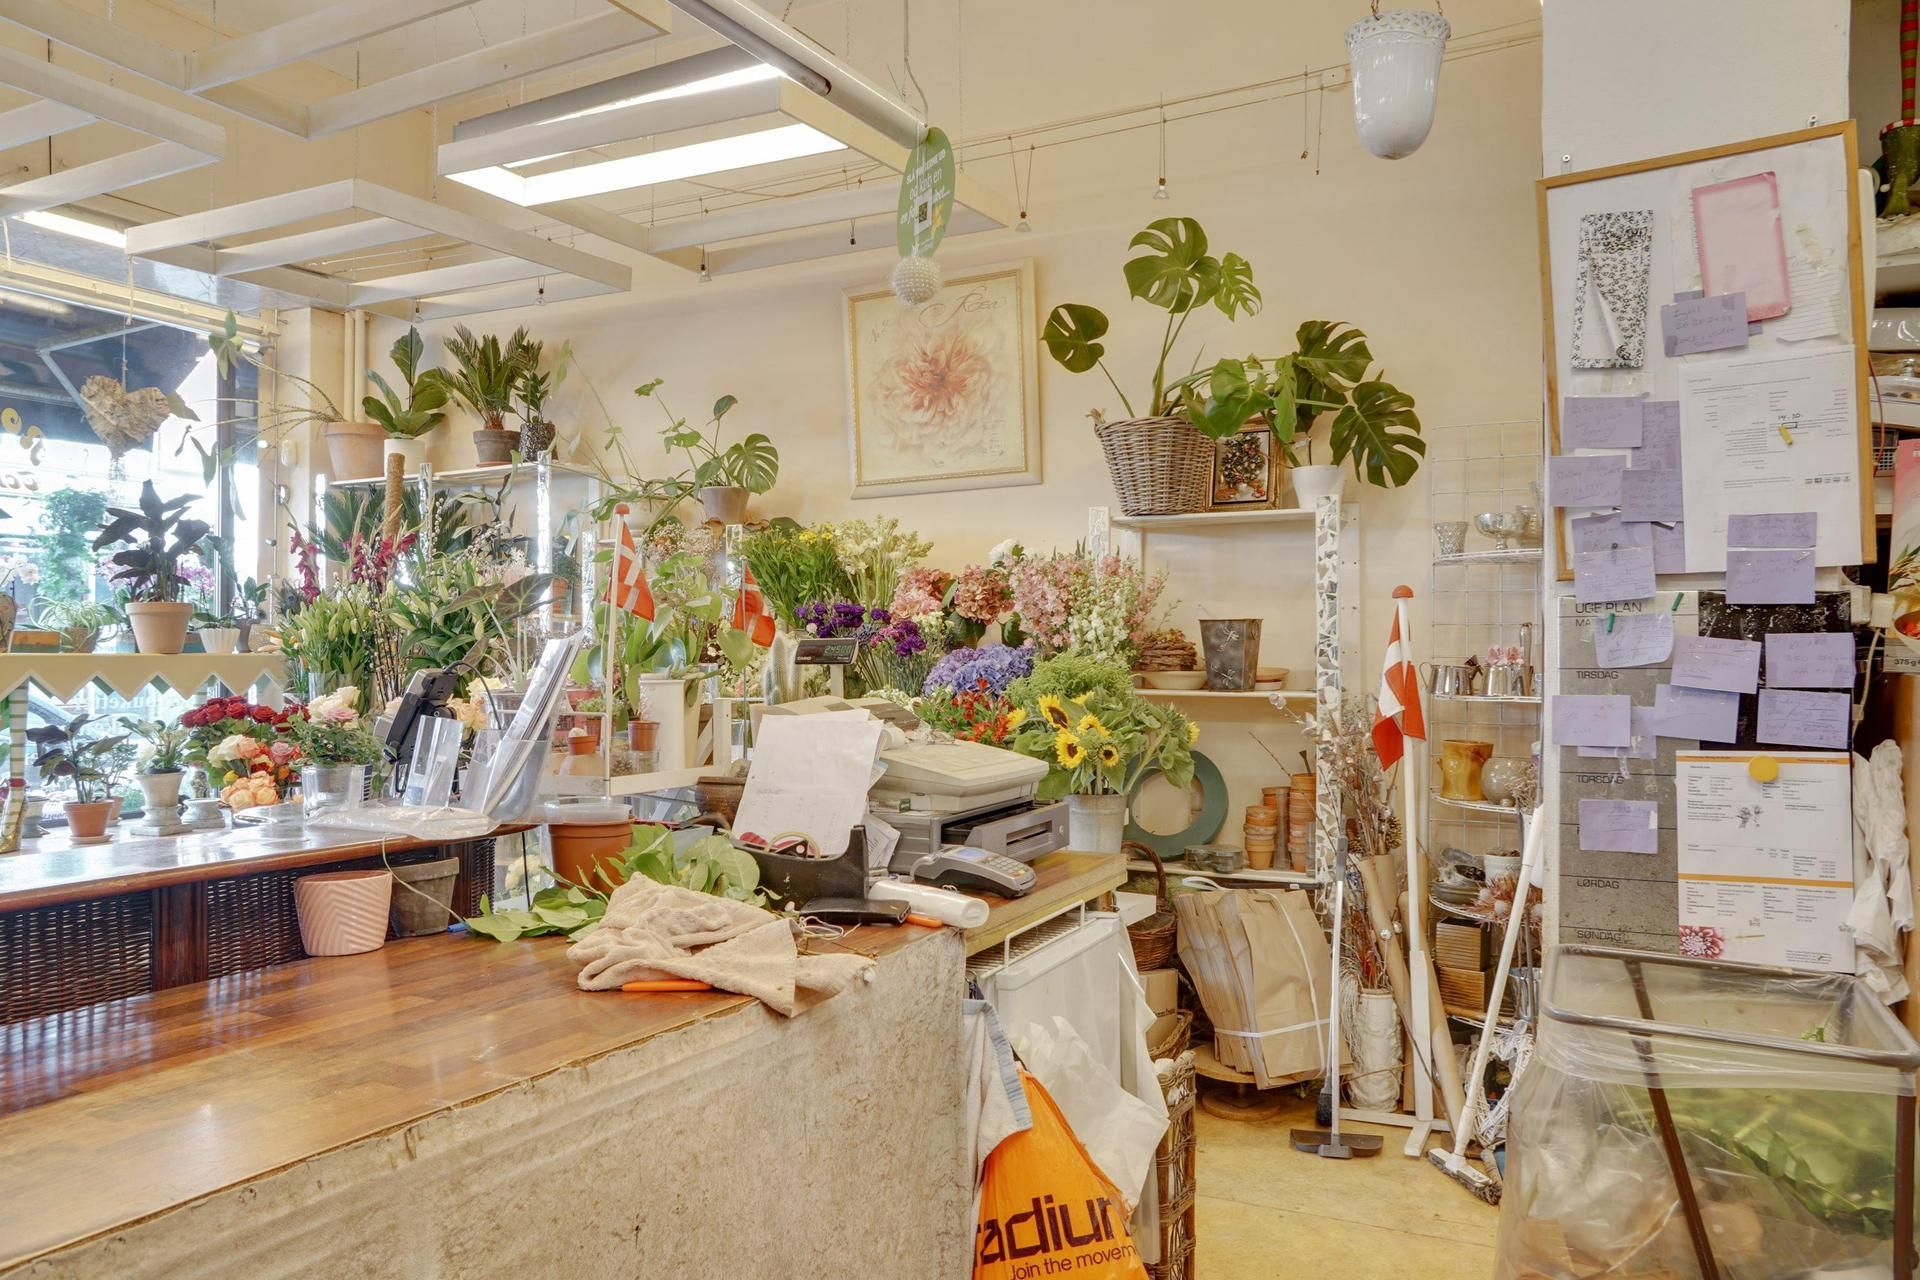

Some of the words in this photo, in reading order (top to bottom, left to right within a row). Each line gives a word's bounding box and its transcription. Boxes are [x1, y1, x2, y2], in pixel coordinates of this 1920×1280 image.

[1605, 602, 1642, 613] PLAN
[1576, 670, 1619, 680] TIRSDAG
[1576, 774, 1625, 785] TORSDAG
[1576, 878, 1620, 889] LØRDAG
[1576, 929, 1622, 942] SØNDAG
[1010, 1260, 1041, 1280] Join
[1043, 1257, 1073, 1274] the
[1076, 1245, 1138, 1266] movem
